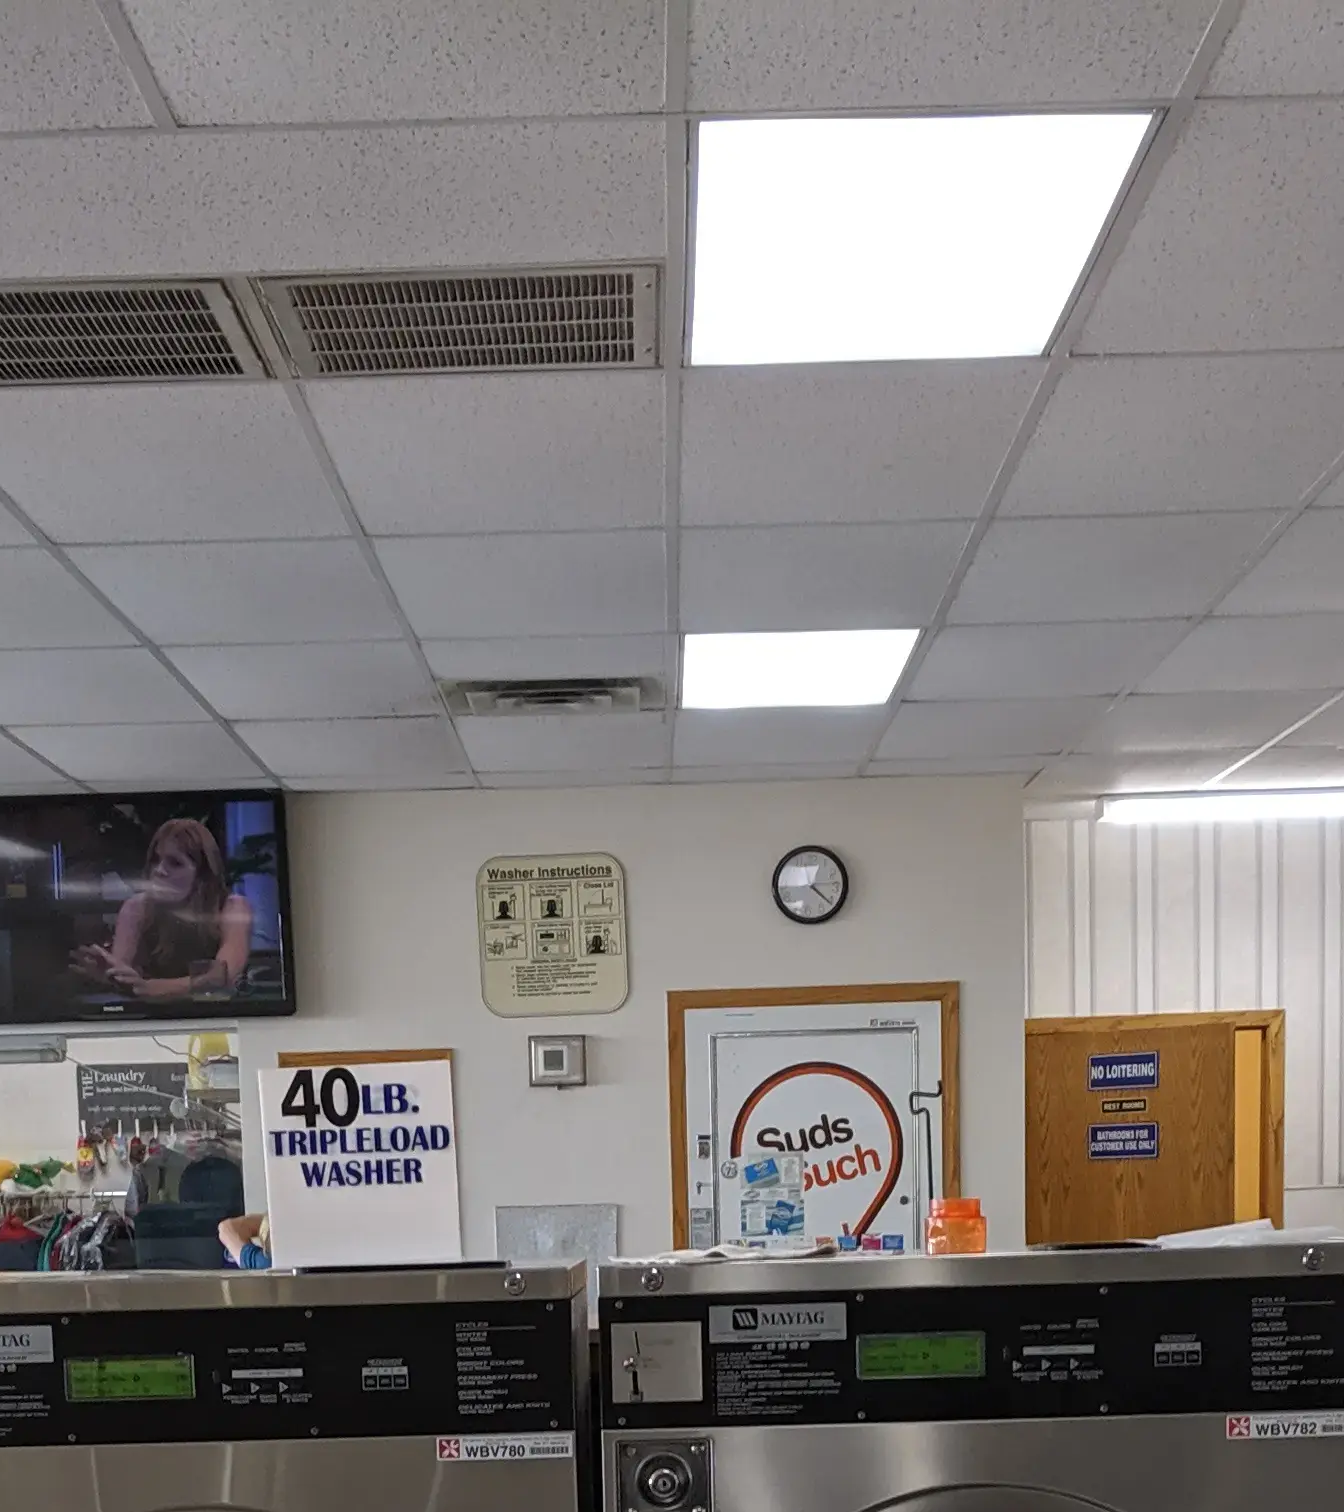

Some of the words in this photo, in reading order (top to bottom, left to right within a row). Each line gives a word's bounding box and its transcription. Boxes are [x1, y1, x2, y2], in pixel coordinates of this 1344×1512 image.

[487, 868, 534, 879] Washer
[538, 865, 612, 878] Instructions
[95, 1070, 146, 1084] Laundry
[1091, 1066, 1104, 1079] NO
[1106, 1063, 1154, 1079] LOITERING
[281, 1067, 360, 1127] 40
[362, 1083, 420, 1115] LB.
[757, 1114, 853, 1152] Suds
[1097, 1130, 1134, 1140] BATHROOMS
[1136, 1129, 1149, 1139] FOR
[269, 1125, 450, 1156] TRIPLELOAD
[1091, 1142, 1123, 1151] CUSTOMER
[1125, 1141, 1137, 1149] USE
[1139, 1140, 1155, 1149] ONLY
[300, 1158, 423, 1188] WASHER
[761, 1311, 824, 1325] MAYTAG
[1255, 1423, 1317, 1435] WBV782
[465, 1445, 526, 1458] WBV780
